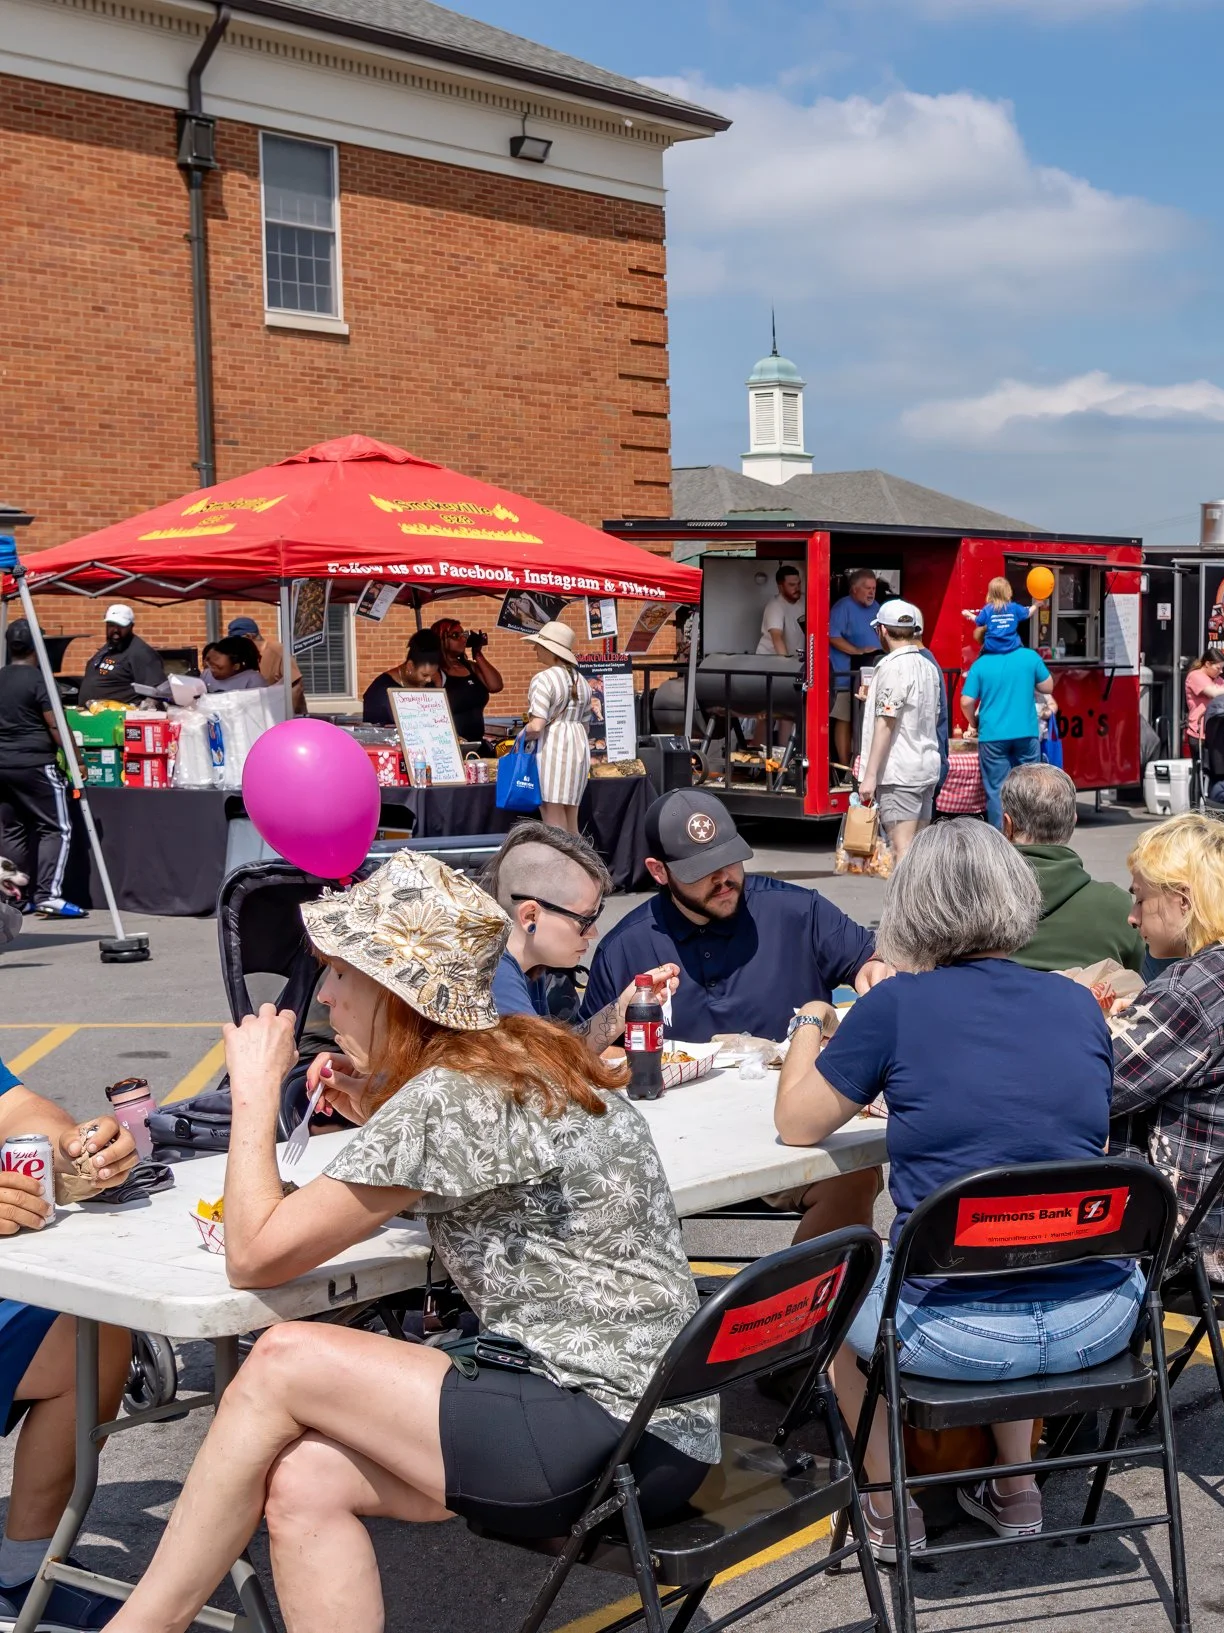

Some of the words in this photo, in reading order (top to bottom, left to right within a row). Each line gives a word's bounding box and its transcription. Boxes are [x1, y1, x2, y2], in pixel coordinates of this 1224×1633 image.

[399, 500, 492, 516] Smokeville
[387, 564, 410, 575] us
[413, 564, 436, 575] on
[439, 562, 520, 584] Facebook,
[524, 569, 600, 590] Instagram
[604, 578, 616, 592] &
[2, 1152, 45, 1181] ke
[13, 1150, 38, 1159] Diet
[971, 1210, 1035, 1223] Simmons
[1038, 1207, 1073, 1220] Bank
[328, 1272, 358, 1305] 4
[729, 1311, 782, 1335] Simmons
[785, 1298, 810, 1317] Bank
